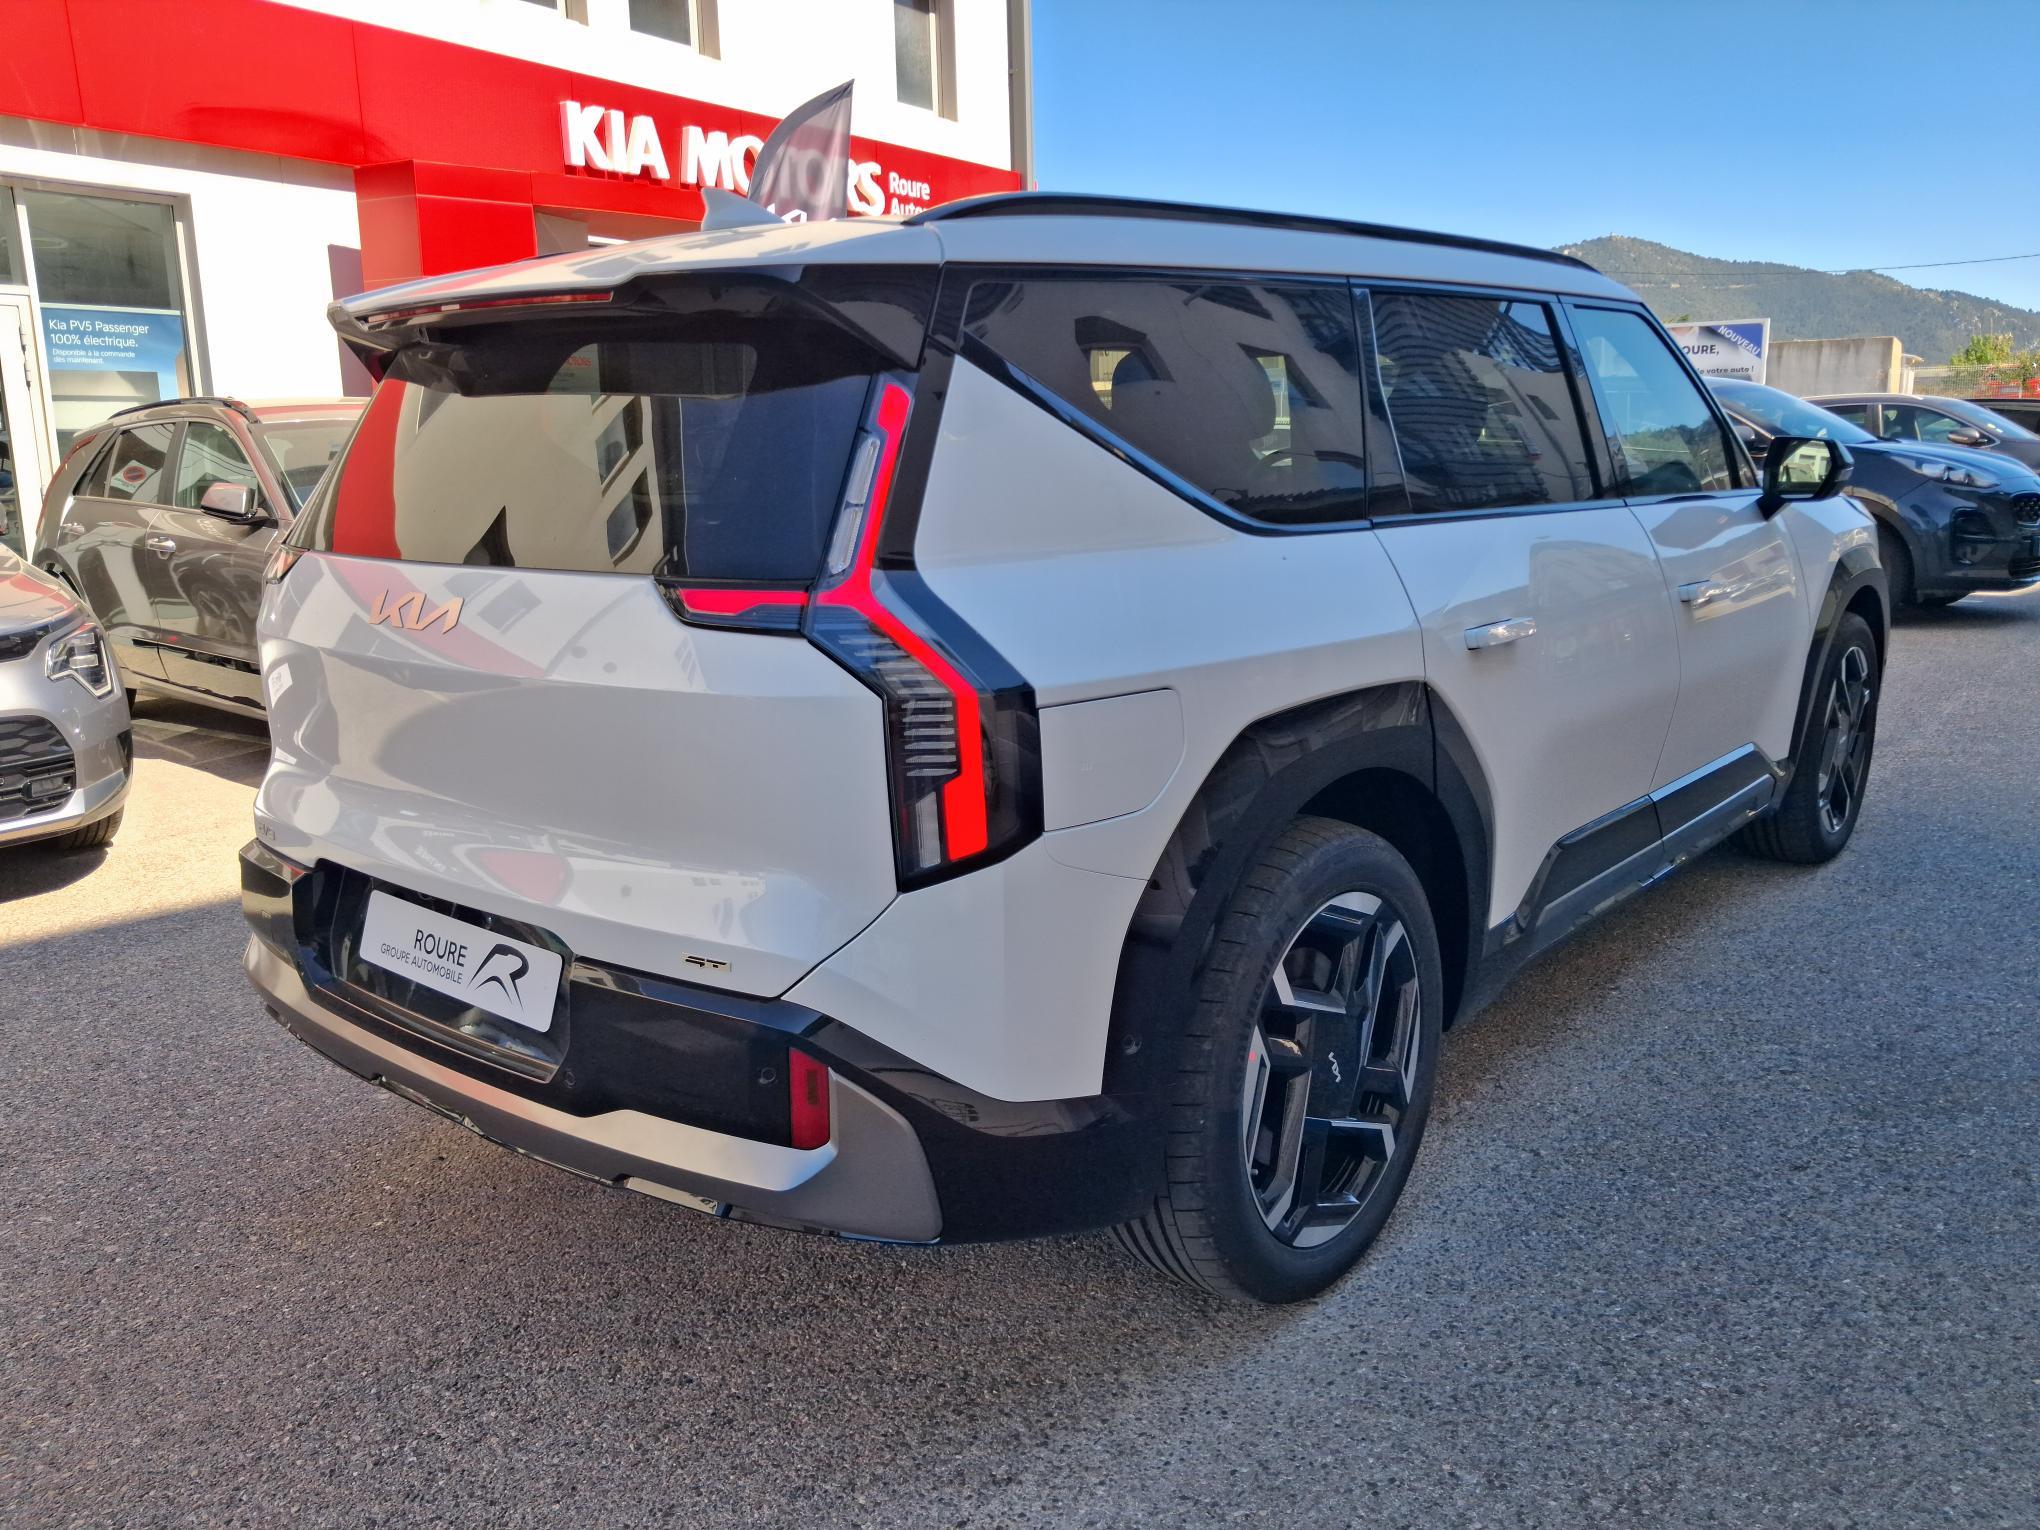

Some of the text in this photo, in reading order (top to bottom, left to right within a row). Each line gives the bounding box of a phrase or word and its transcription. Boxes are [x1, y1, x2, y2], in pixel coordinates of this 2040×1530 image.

[560, 100, 670, 179] KIA
[889, 171, 931, 200] Roure
[48, 319, 149, 336] Kia PV5 Passenger
[50, 333, 138, 349] 100% électrique.
[1718, 325, 1760, 355] NOUVEAU
[52, 348, 87, 357] Disponible
[1682, 344, 1720, 356] OURE,
[413, 929, 468, 968] ROURE
[380, 943, 463, 985] GROUPE AUTOMOBILE
